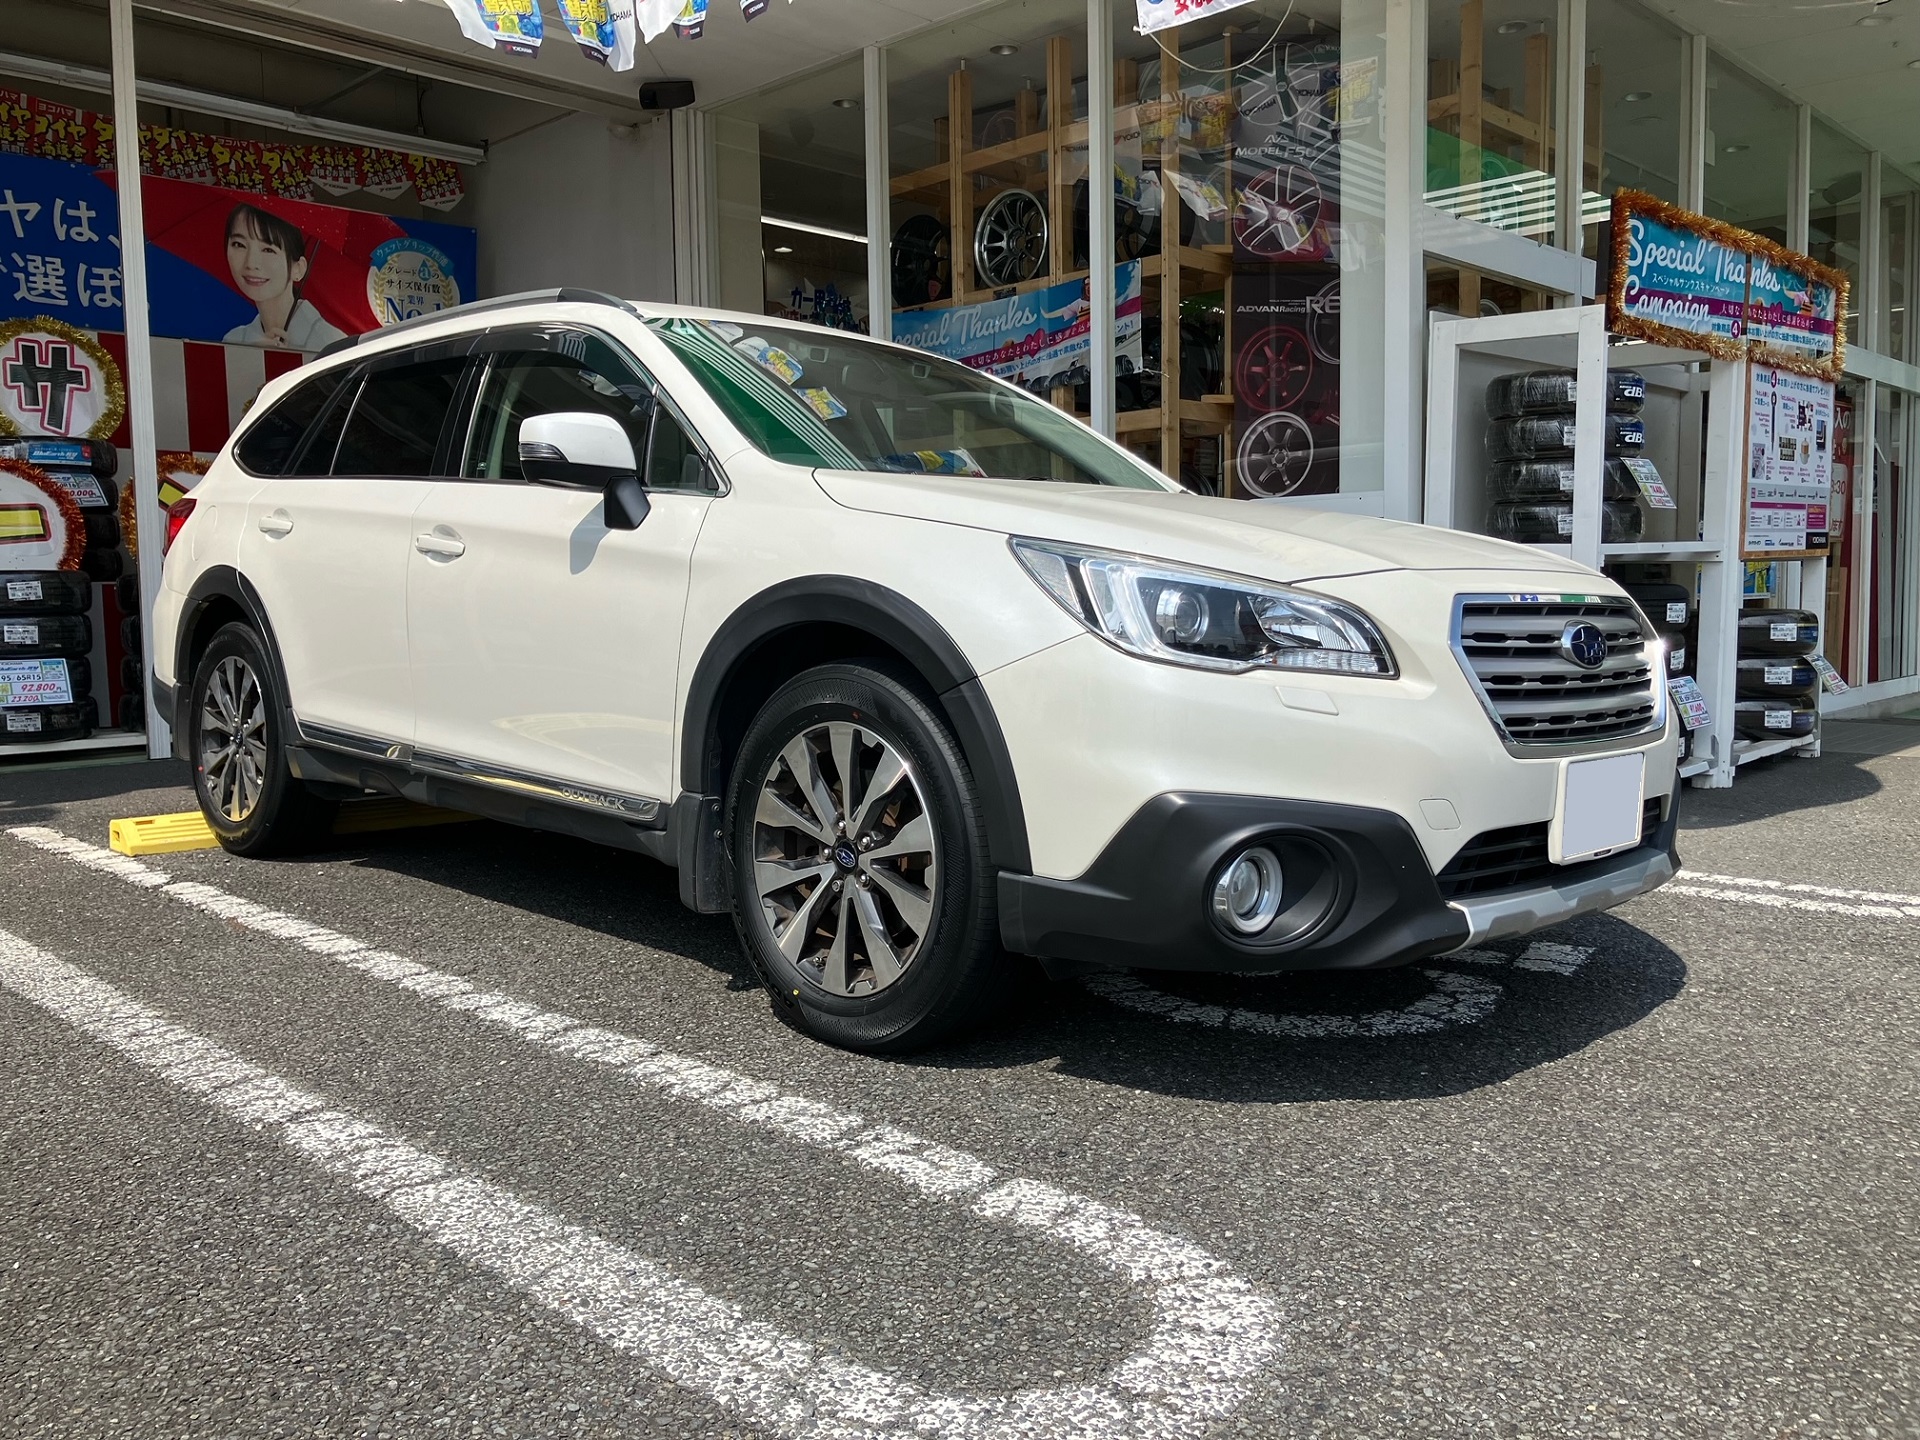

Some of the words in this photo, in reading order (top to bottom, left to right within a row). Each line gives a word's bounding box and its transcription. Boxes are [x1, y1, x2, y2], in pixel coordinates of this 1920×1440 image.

[38, 102, 75, 116] ヨコハマ
[1235, 146, 1282, 156] MODEL
[1627, 219, 1705, 276] Special
[1709, 241, 1781, 292] Thanks
[386, 279, 441, 294] サイズ保有数
[1236, 305, 1280, 313] ADVAN
[1279, 305, 1306, 314] Racing
[1623, 274, 1710, 331] Campaign
[893, 312, 950, 349] pecial
[952, 295, 1037, 346] Thanks
[1624, 386, 1643, 398] dB
[1624, 431, 1643, 443] dB
[561, 786, 626, 811] OUTBACK
